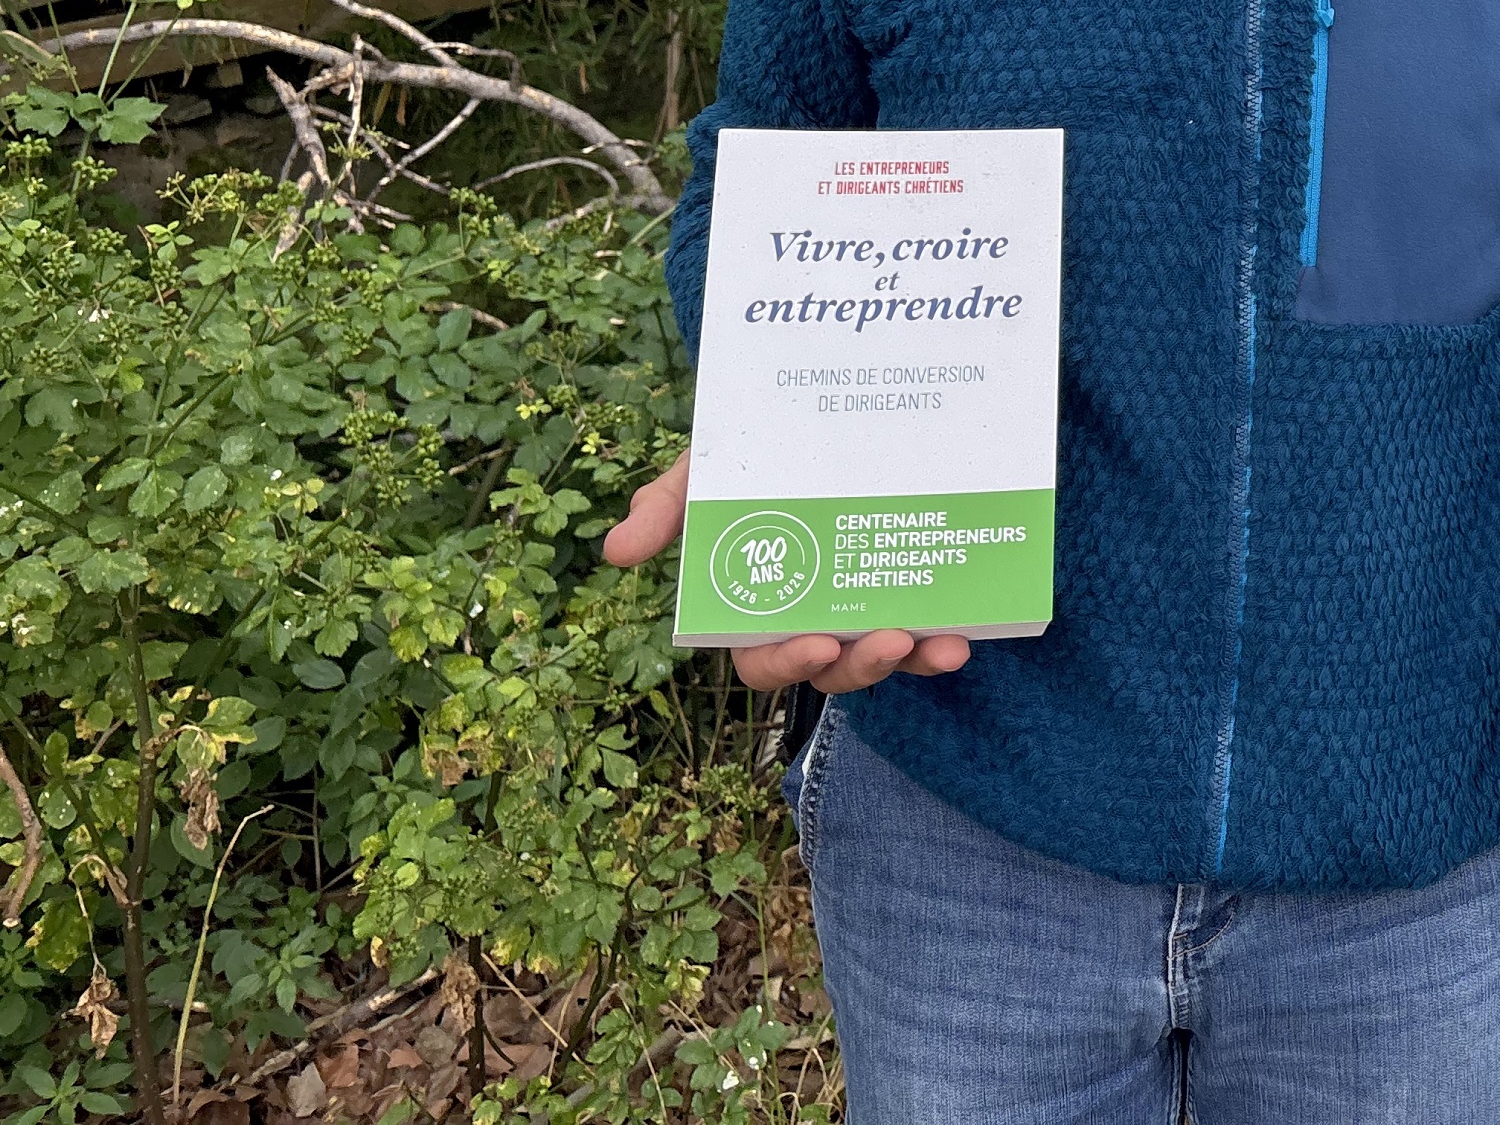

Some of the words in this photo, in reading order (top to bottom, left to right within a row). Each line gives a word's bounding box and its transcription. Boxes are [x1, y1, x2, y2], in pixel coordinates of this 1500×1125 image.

[834, 162, 855, 175] LES
[860, 161, 950, 175] ENTREPRENEURS
[818, 181, 832, 195] ET
[836, 181, 900, 195] DIRIGEANTS
[904, 177, 964, 194] CHRÉTIENS
[769, 229, 886, 269] Vivre,
[892, 227, 1009, 261] croire
[874, 271, 900, 291] et
[744, 285, 1023, 333] entreprendre
[776, 368, 852, 387] CHEMINS
[856, 368, 878, 385] DE
[882, 365, 985, 385] CONVERSION
[818, 395, 839, 412] DE
[844, 392, 942, 412] DIRIGEANTS
[836, 511, 948, 531] CENTENAIRE
[834, 533, 870, 550] DES
[874, 526, 1027, 549] ENTREPRENEURS
[740, 536, 788, 567] 100
[834, 553, 856, 569] ET
[860, 548, 967, 569] DIRIGEANTS
[750, 562, 785, 585] ANS
[832, 567, 934, 589] CHRÉTIENS
[728, 580, 758, 604] 1926
[776, 571, 806, 601] 2026
[831, 602, 867, 613] MAME
